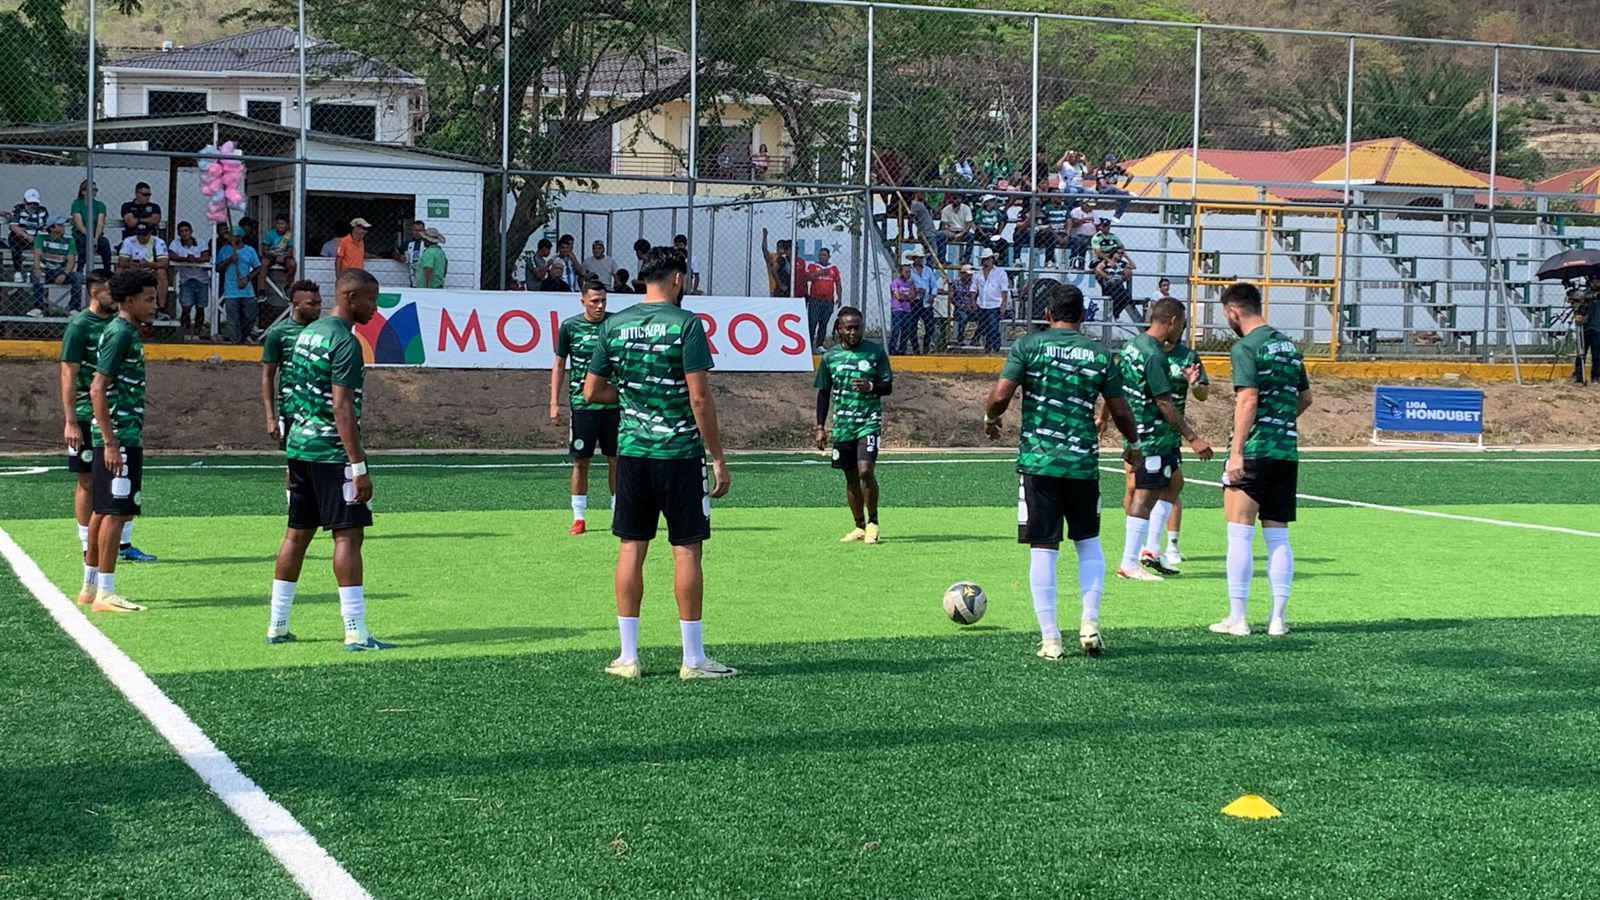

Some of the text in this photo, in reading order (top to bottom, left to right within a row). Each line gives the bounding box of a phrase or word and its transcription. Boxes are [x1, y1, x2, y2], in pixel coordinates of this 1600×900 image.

[438, 307, 806, 355] MOROS
[618, 323, 667, 340] JUTICALPA
[1044, 345, 1095, 363] JUTICALPA
[1405, 401, 1428, 409] LIGA
[1405, 409, 1481, 422] HONDUBET
[866, 434, 876, 446] 13
